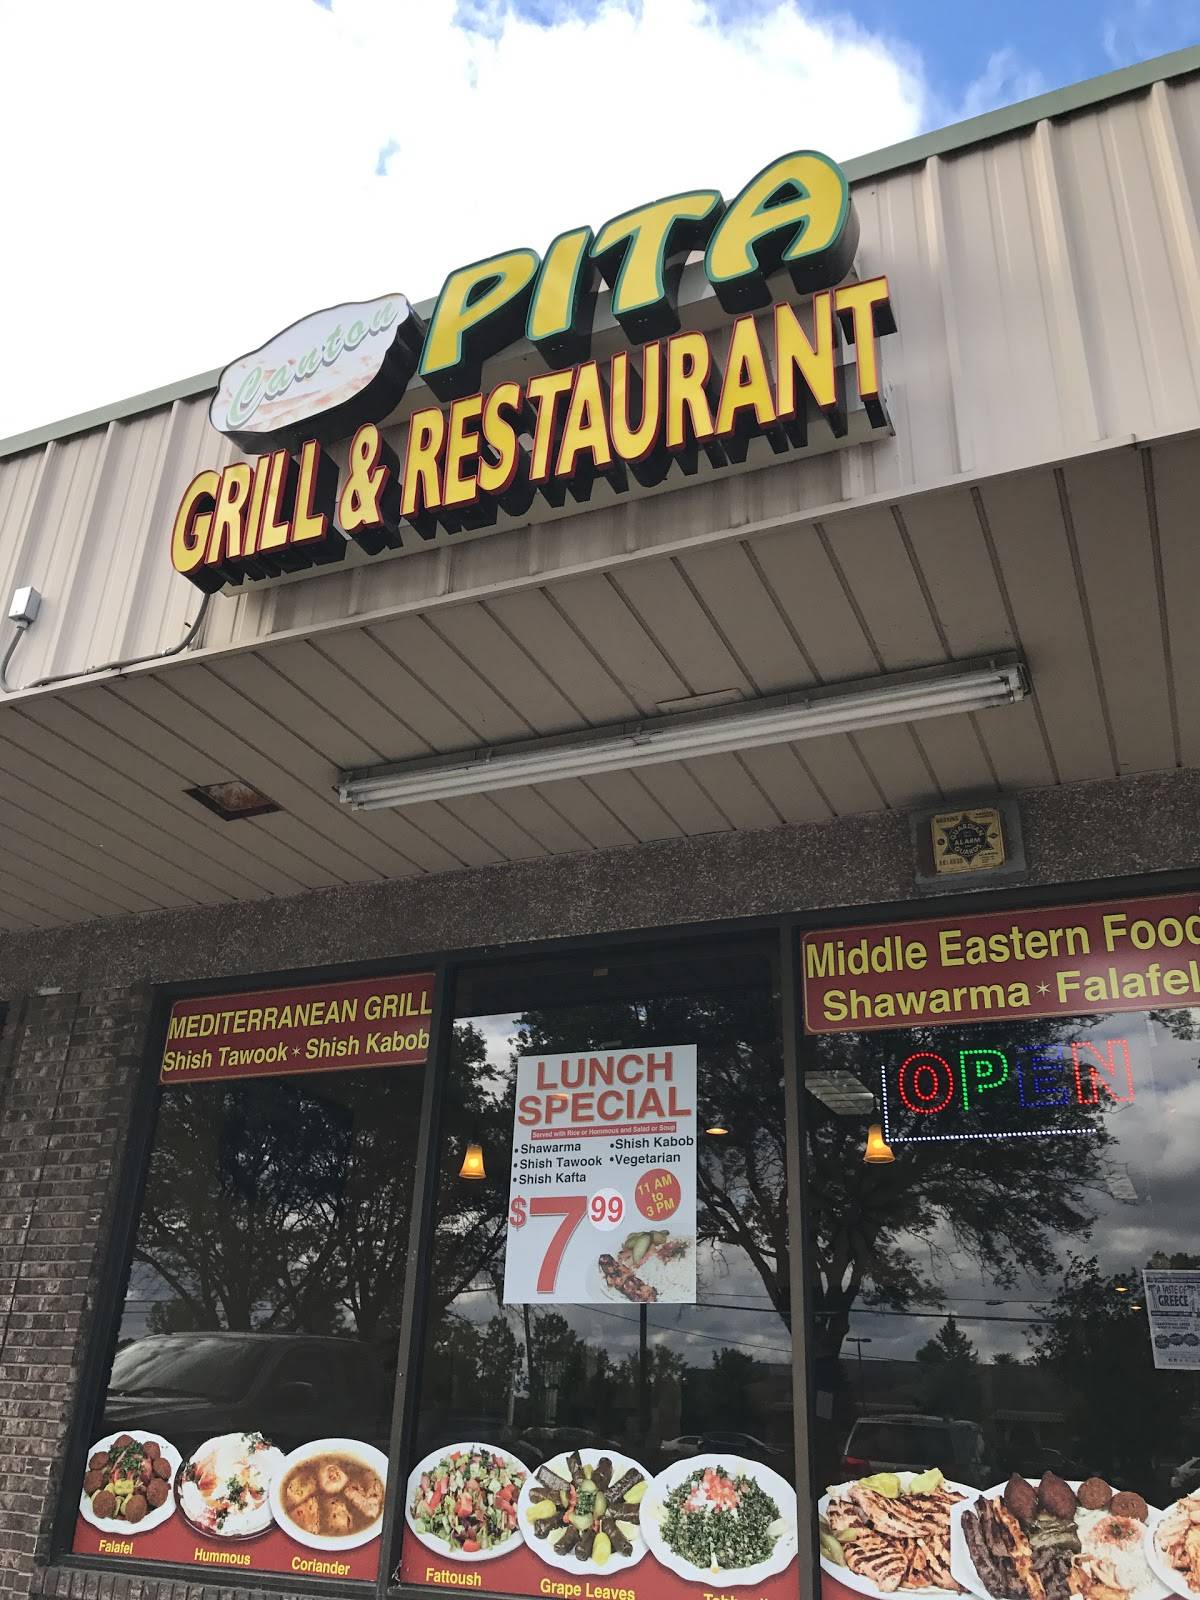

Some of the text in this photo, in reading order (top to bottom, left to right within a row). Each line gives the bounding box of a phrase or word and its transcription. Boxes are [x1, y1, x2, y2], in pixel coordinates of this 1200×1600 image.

[417, 149, 850, 377] PITA
[226, 301, 398, 429] Canton
[170, 275, 889, 577] GRILL & RESTAURANT
[806, 935, 928, 978] Middle
[939, 924, 1090, 967] Eastern
[823, 961, 1200, 1021] Shawarma Falafel
[168, 990, 433, 1040] MEDITERRANEAN GRILL
[163, 1028, 430, 1072] Shish Tawook Shish Kabob
[536, 1051, 673, 1091] LUNCH
[898, 1039, 1135, 1115] OPEN
[517, 1086, 692, 1126] SPECIAL
[620, 1126, 632, 1134] and
[633, 1125, 649, 1133] Salad
[659, 1124, 676, 1132] Soup
[520, 1142, 581, 1154] Shawarma
[615, 1136, 694, 1150] Shish Kabob
[519, 1156, 602, 1170] Shish Tawook
[615, 1153, 681, 1167] Vegetarian
[518, 1172, 587, 1185] Shish Kafta
[638, 1174, 673, 1196] 11 AM
[646, 1198, 675, 1217] 3 PM
[651, 1192, 664, 1203] to
[1158, 1294, 1189, 1307] GREECE
[98, 1539, 134, 1555] Falafel
[194, 1547, 251, 1566] Hummous
[291, 1556, 351, 1576] Coriander
[425, 1567, 482, 1587] Fattoush
[540, 1578, 636, 1600] Grape Leaves
